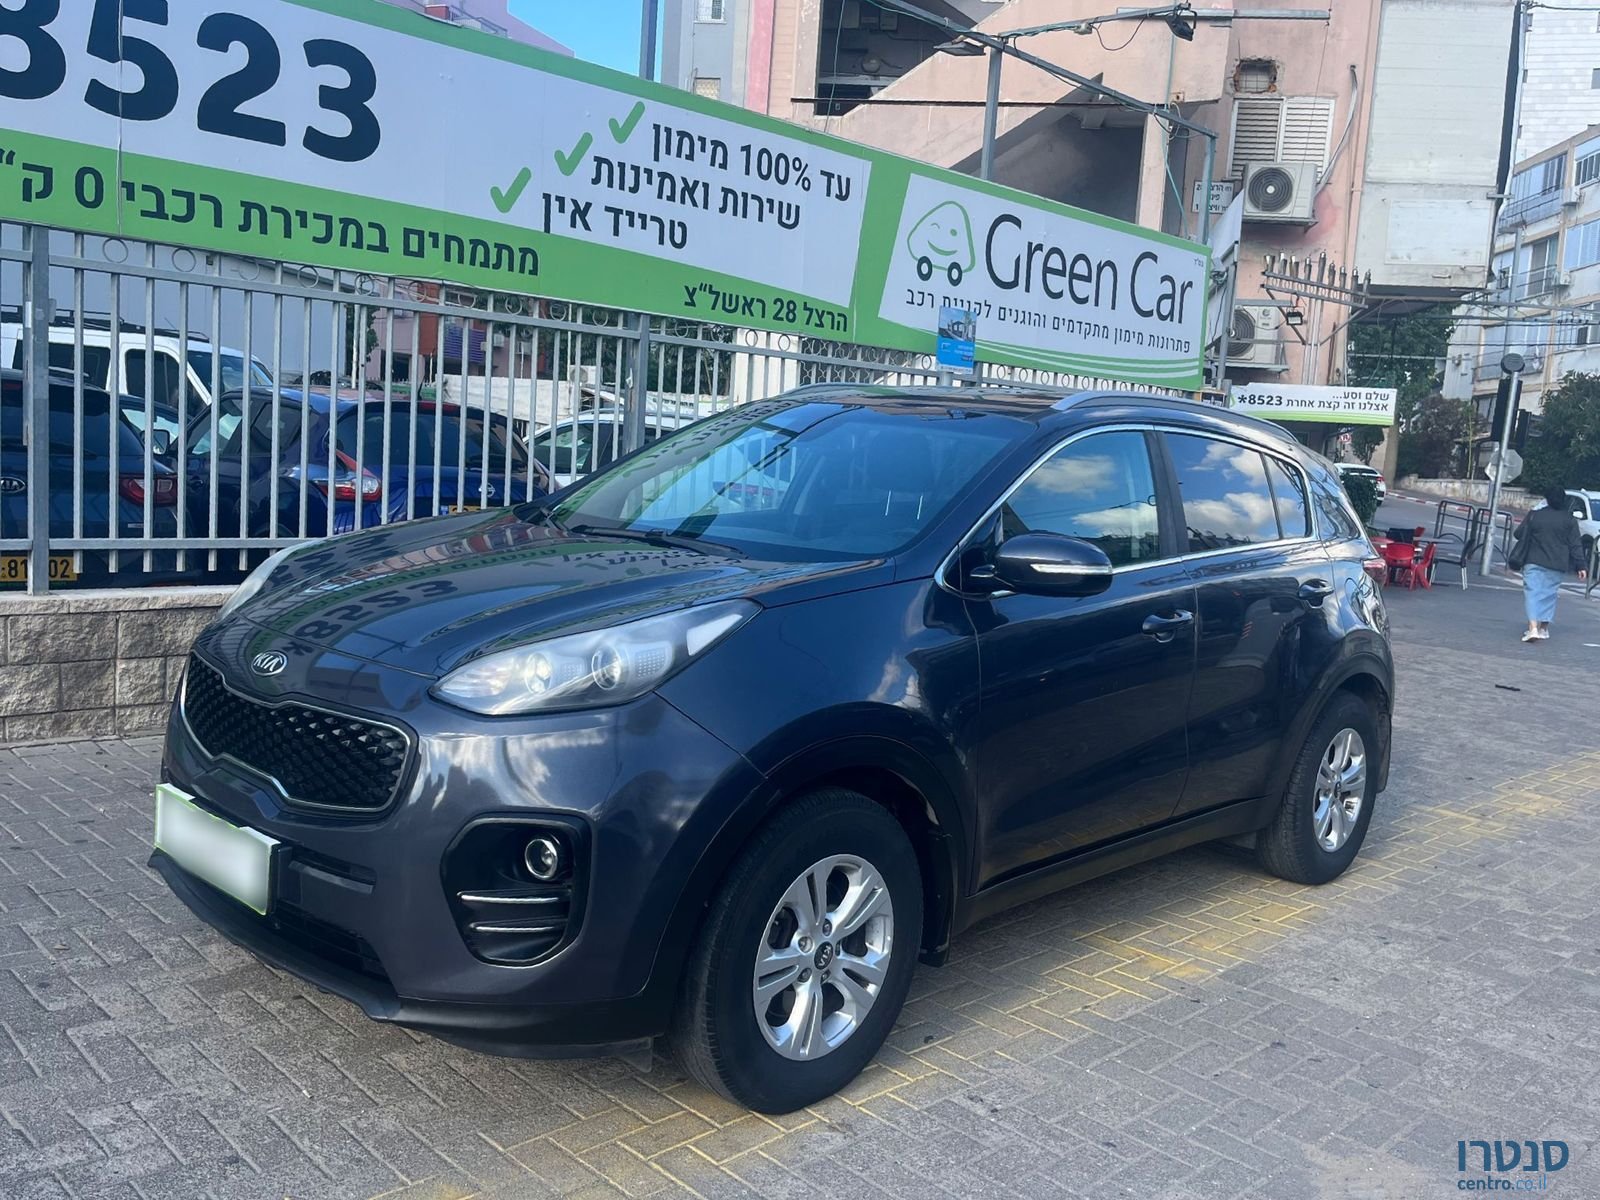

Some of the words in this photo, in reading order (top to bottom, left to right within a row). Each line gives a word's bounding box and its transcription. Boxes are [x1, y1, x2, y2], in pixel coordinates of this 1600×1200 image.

[651, 122, 729, 171] מימון
[590, 154, 710, 211] ואמינות
[739, 144, 812, 192] 100%
[819, 169, 852, 202] עד
[121, 180, 223, 229] רכבי
[541, 192, 593, 235] אין
[718, 185, 801, 230] שירות
[238, 199, 390, 254] במכירת
[604, 205, 688, 250] טרייד
[403, 226, 539, 276] מתמחים
[985, 213, 1119, 311] Green
[1130, 251, 1194, 325] Car
[772, 297, 798, 324] 28
[906, 288, 935, 309] רכב
[801, 301, 849, 334] הרצל
[997, 304, 1047, 330] והוגנים
[1051, 315, 1109, 341] מתקדמים
[1113, 327, 1144, 347] מימון
[1148, 333, 1191, 354] פתרונות
[1286, 399, 1315, 408] אחרת
[1317, 400, 1340, 411] קצת
[1343, 401, 1356, 409] זה
[1357, 401, 1389, 411] אצלנו
[1365, 391, 1390, 401] שלם
[253, 653, 284, 672] KIA
